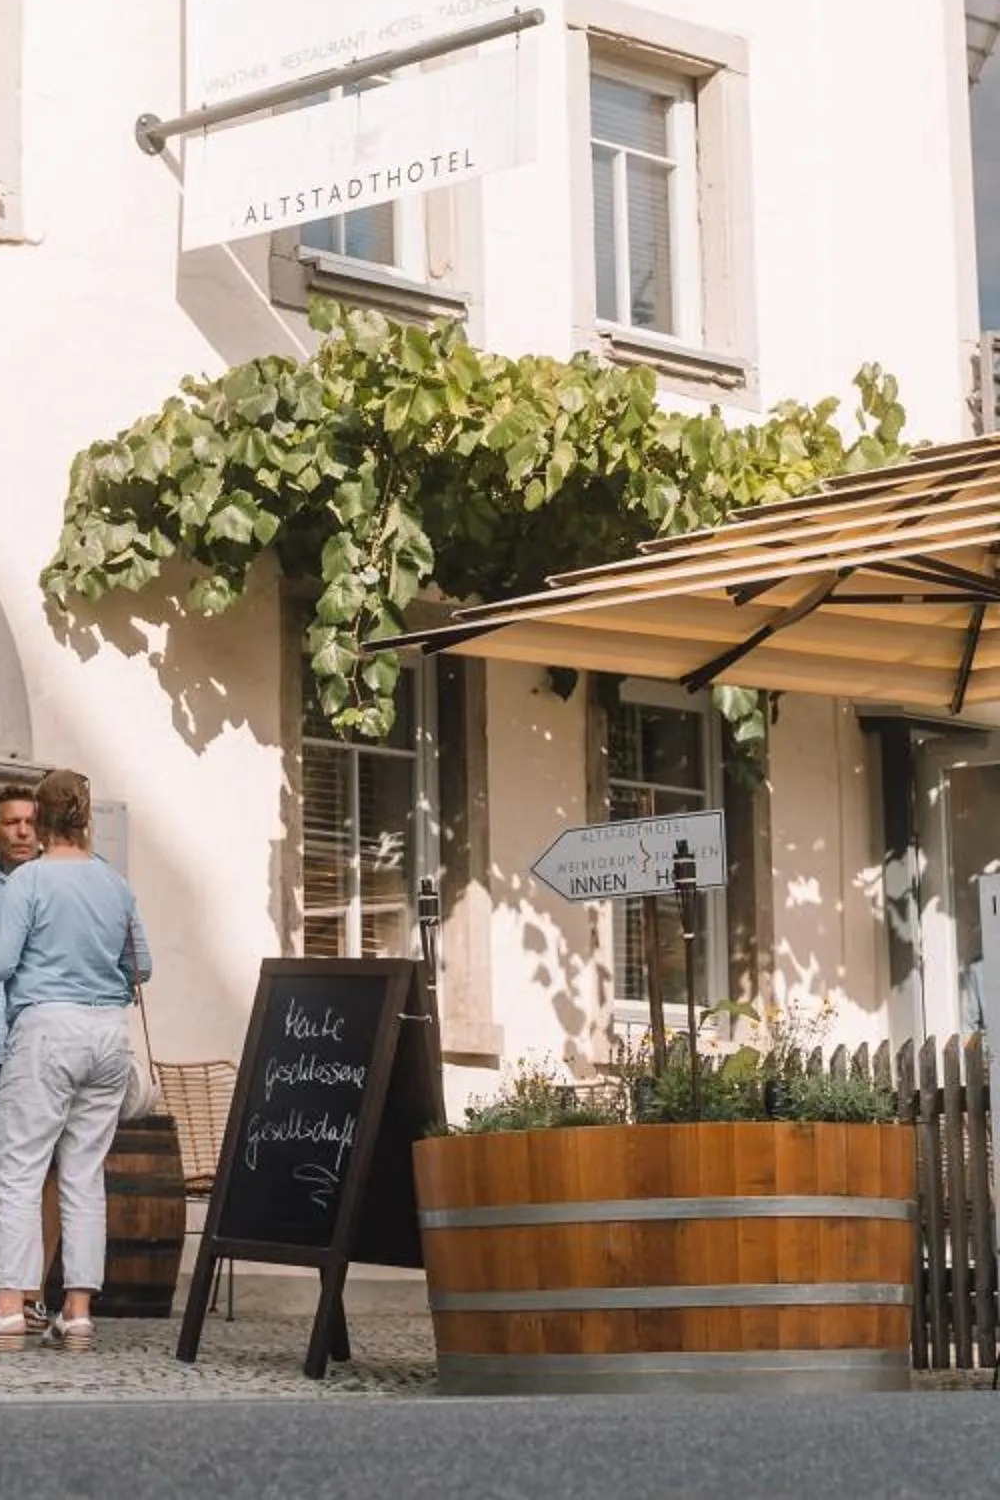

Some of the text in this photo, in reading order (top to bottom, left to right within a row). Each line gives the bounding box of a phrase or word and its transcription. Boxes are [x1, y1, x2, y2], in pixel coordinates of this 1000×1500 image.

[279, 29, 367, 70] RESTAURANT
[378, 12, 425, 42] HOTEL
[243, 147, 475, 225] ALTSTADTHOTEL
[569, 873, 627, 895] INNEN
[284, 997, 346, 1042] Heute
